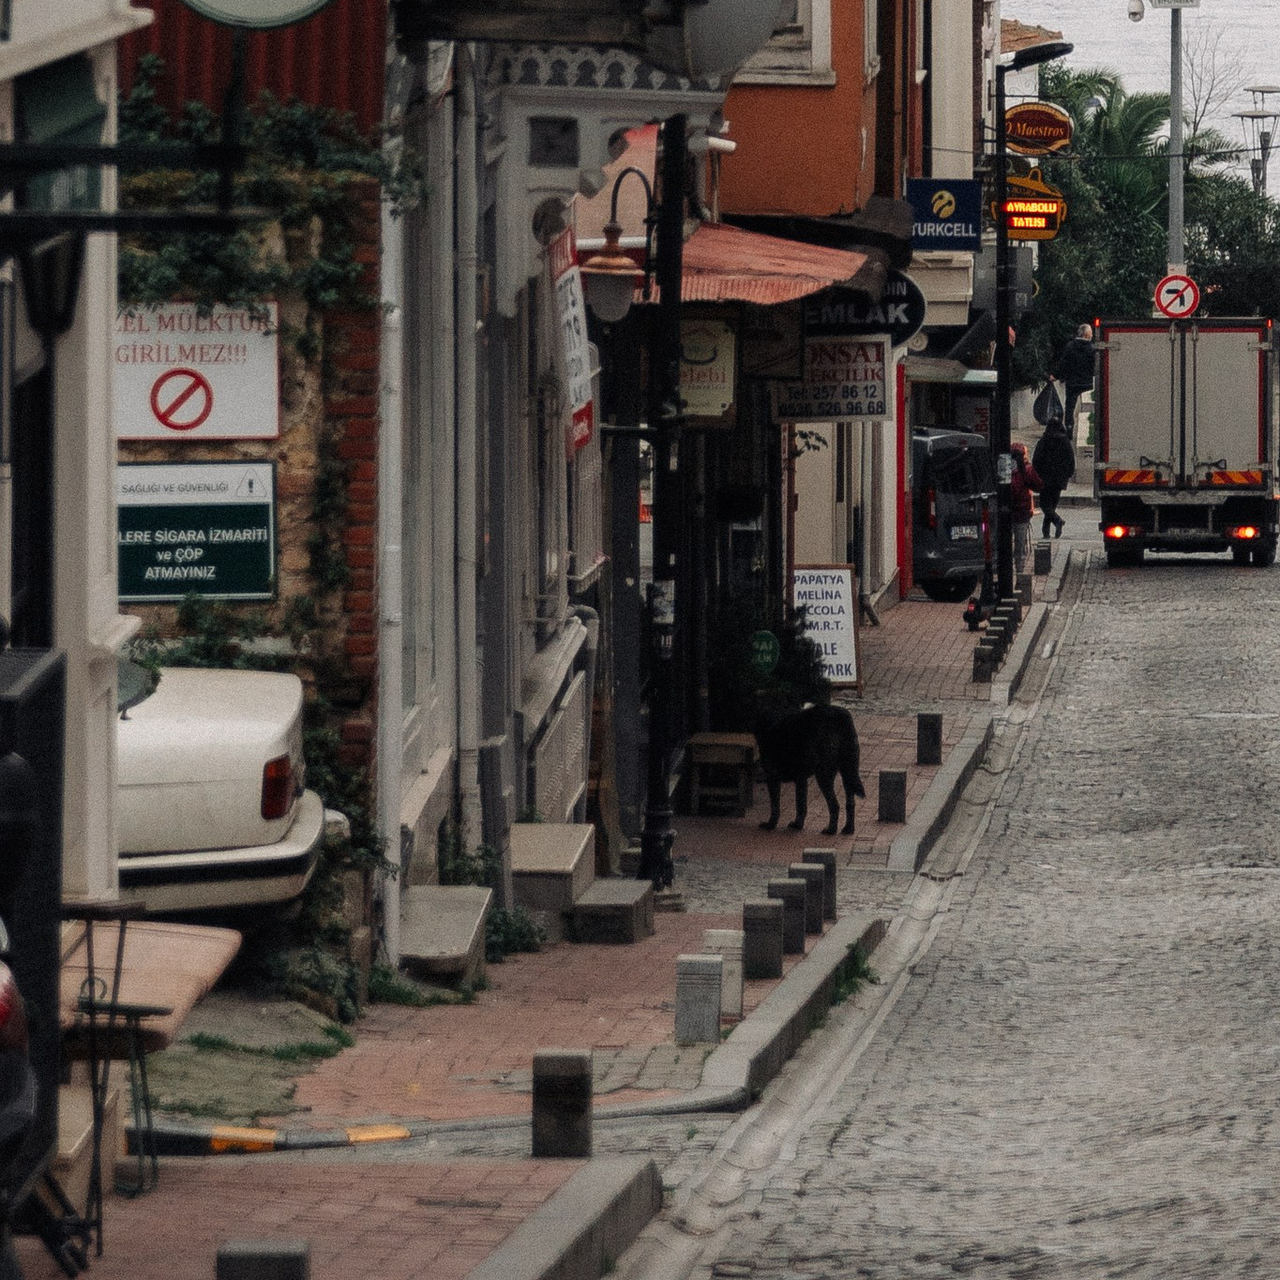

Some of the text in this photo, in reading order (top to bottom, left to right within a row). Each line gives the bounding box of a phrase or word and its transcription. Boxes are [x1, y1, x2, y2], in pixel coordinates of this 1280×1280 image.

[1017, 122, 1065, 137] Maestros
[1006, 202, 1058, 214] AYRABOLU
[912, 222, 977, 237] TURKCELL
[805, 302, 909, 324] EMLAK
[115, 340, 248, 364] GİRİLMEZ!!!
[805, 343, 884, 364] ONSAI
[681, 367, 726, 384] elebi
[864, 385, 878, 398] 12
[163, 483, 175, 493] VE
[118, 526, 268, 544] LERE SİGARA İZMARİTİ
[156, 546, 204, 563] ve ÇÖP
[144, 566, 217, 580] ATMAYINIZ
[794, 575, 844, 585] PAPATYA
[797, 588, 842, 600] MELİNA
[804, 606, 845, 615] CCOLA
[803, 621, 844, 631] M.R.T.
[815, 643, 838, 656] ALE
[821, 664, 853, 676] PARK
